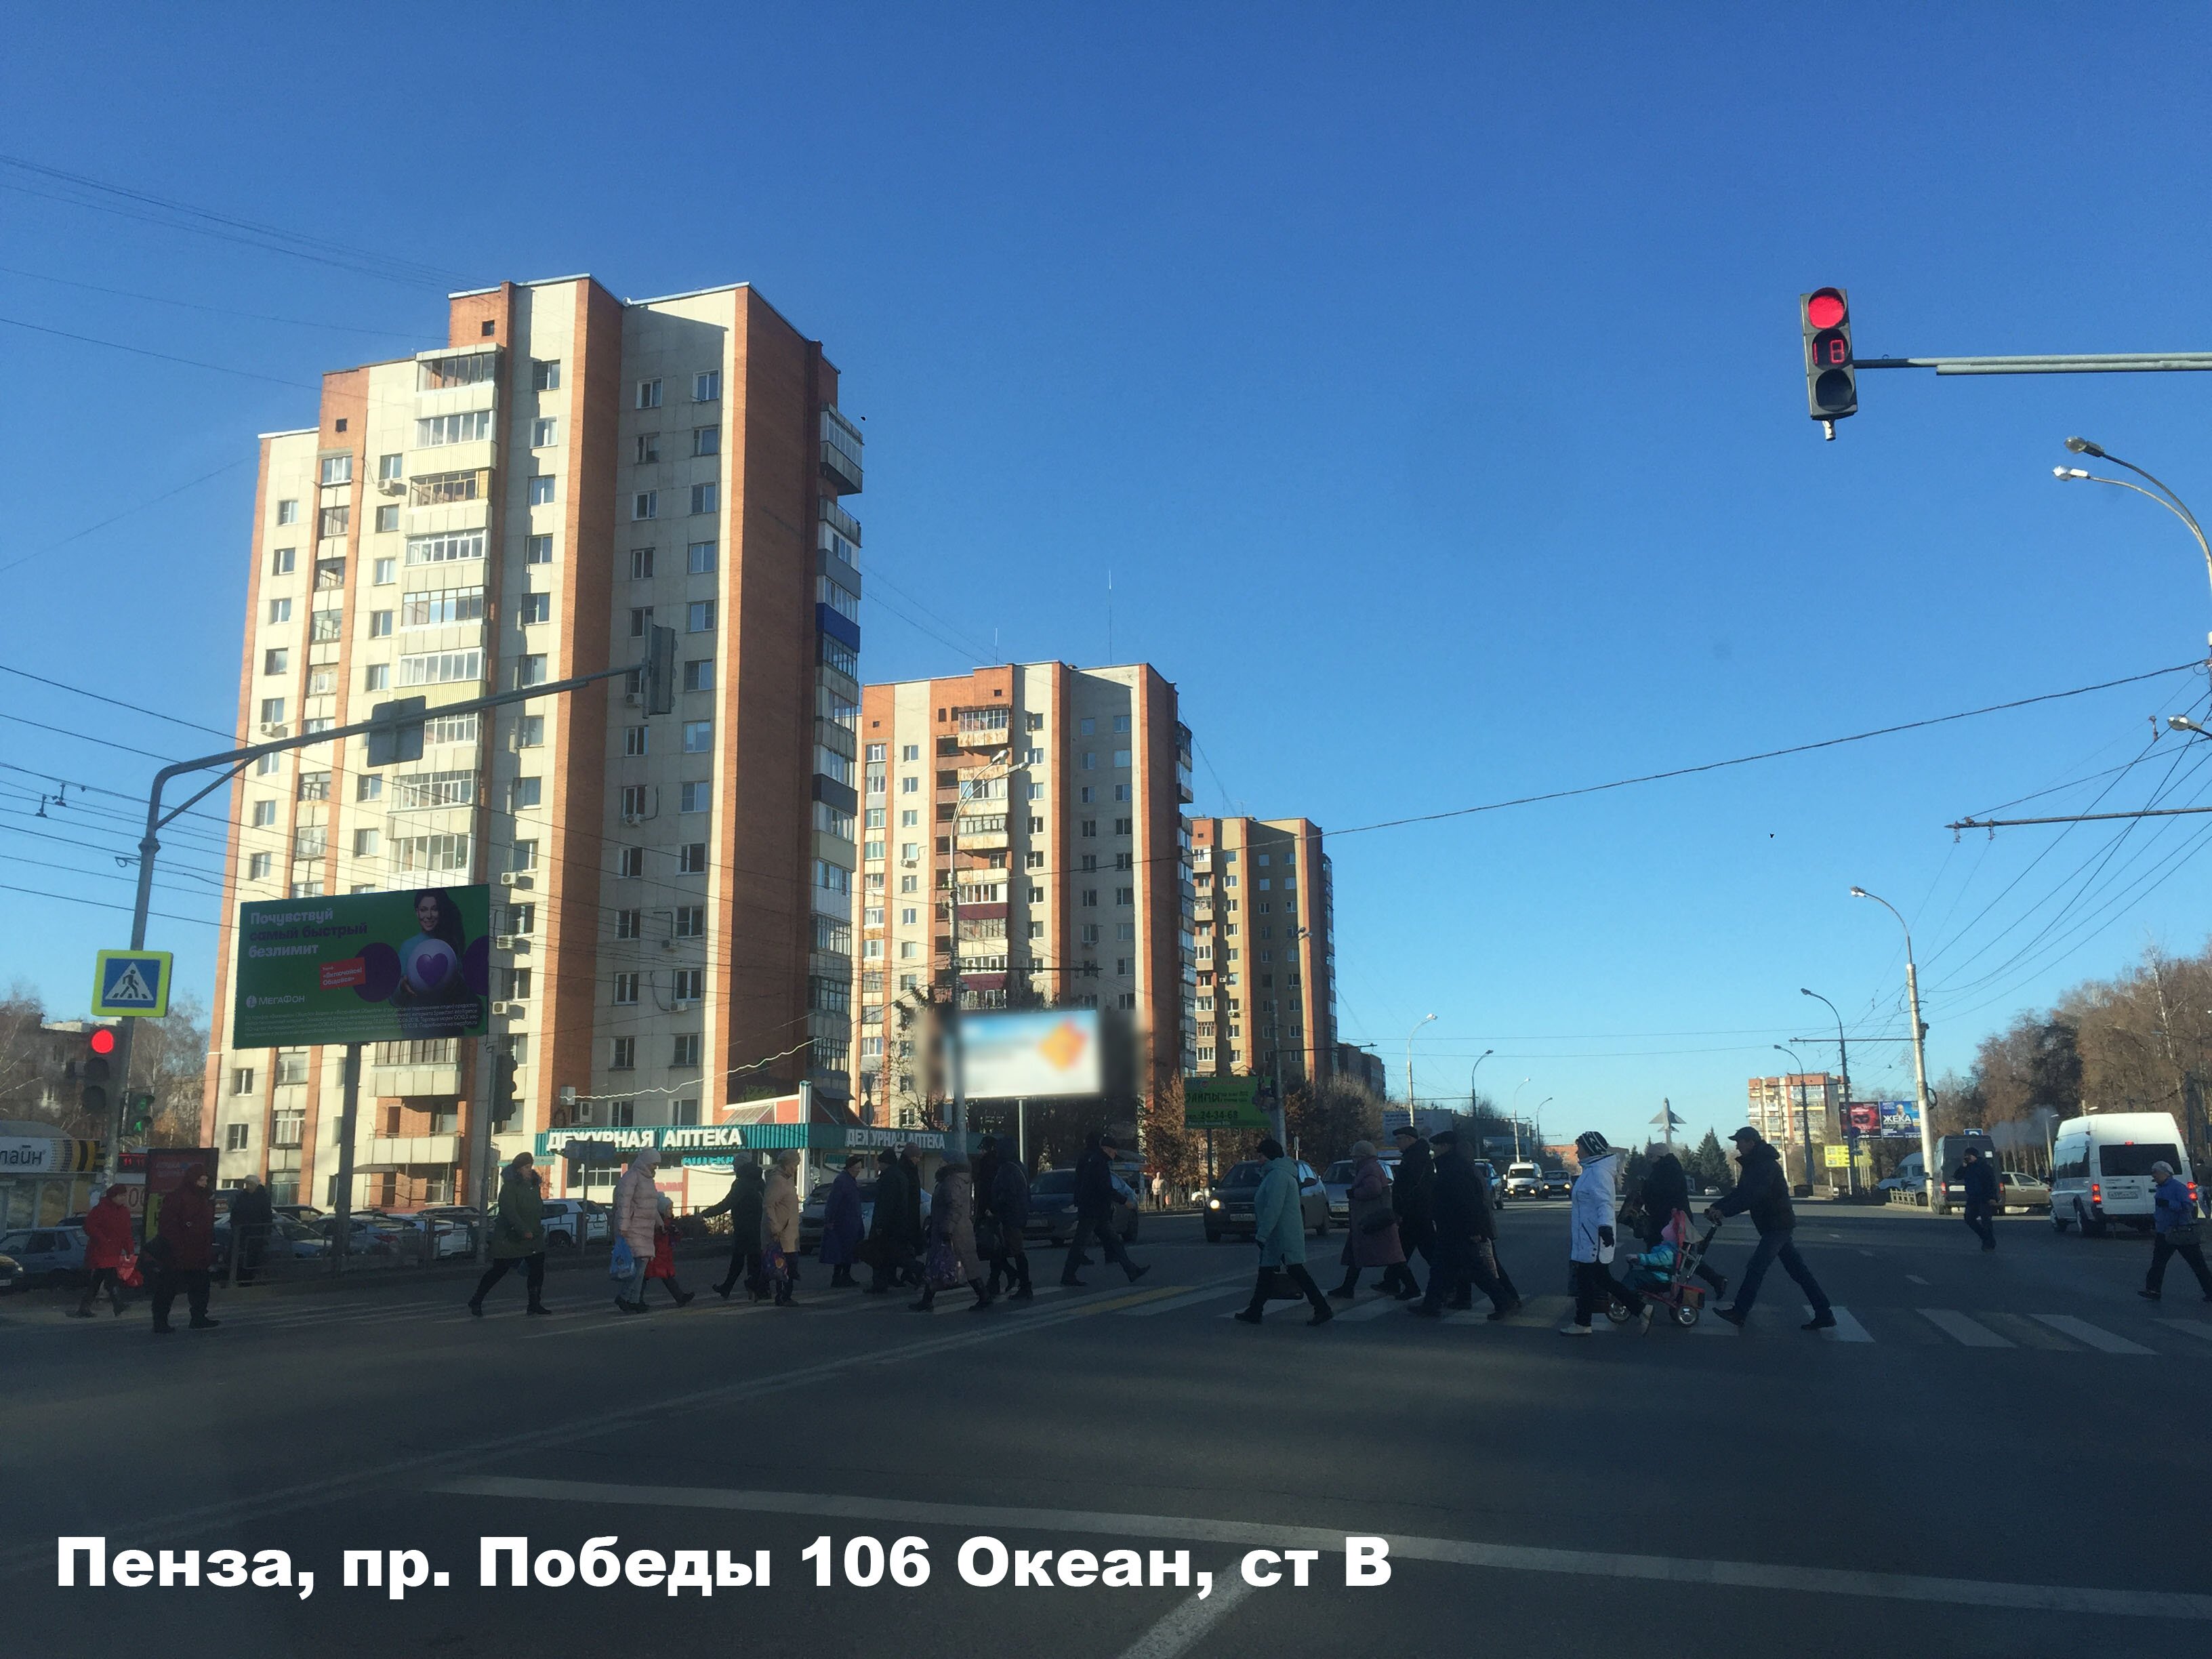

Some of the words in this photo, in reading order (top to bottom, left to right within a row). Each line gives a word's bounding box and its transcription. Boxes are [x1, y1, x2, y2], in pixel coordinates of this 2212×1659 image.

[1812, 339, 1845, 365] 18
[250, 908, 333, 926] Почувствуй
[249, 926, 298, 941] самый
[302, 922, 367, 939] быстрый
[249, 944, 319, 958] безлимит
[662, 1128, 742, 1147] АПТЕКА
[906, 1132, 945, 1149] АПТЕКА
